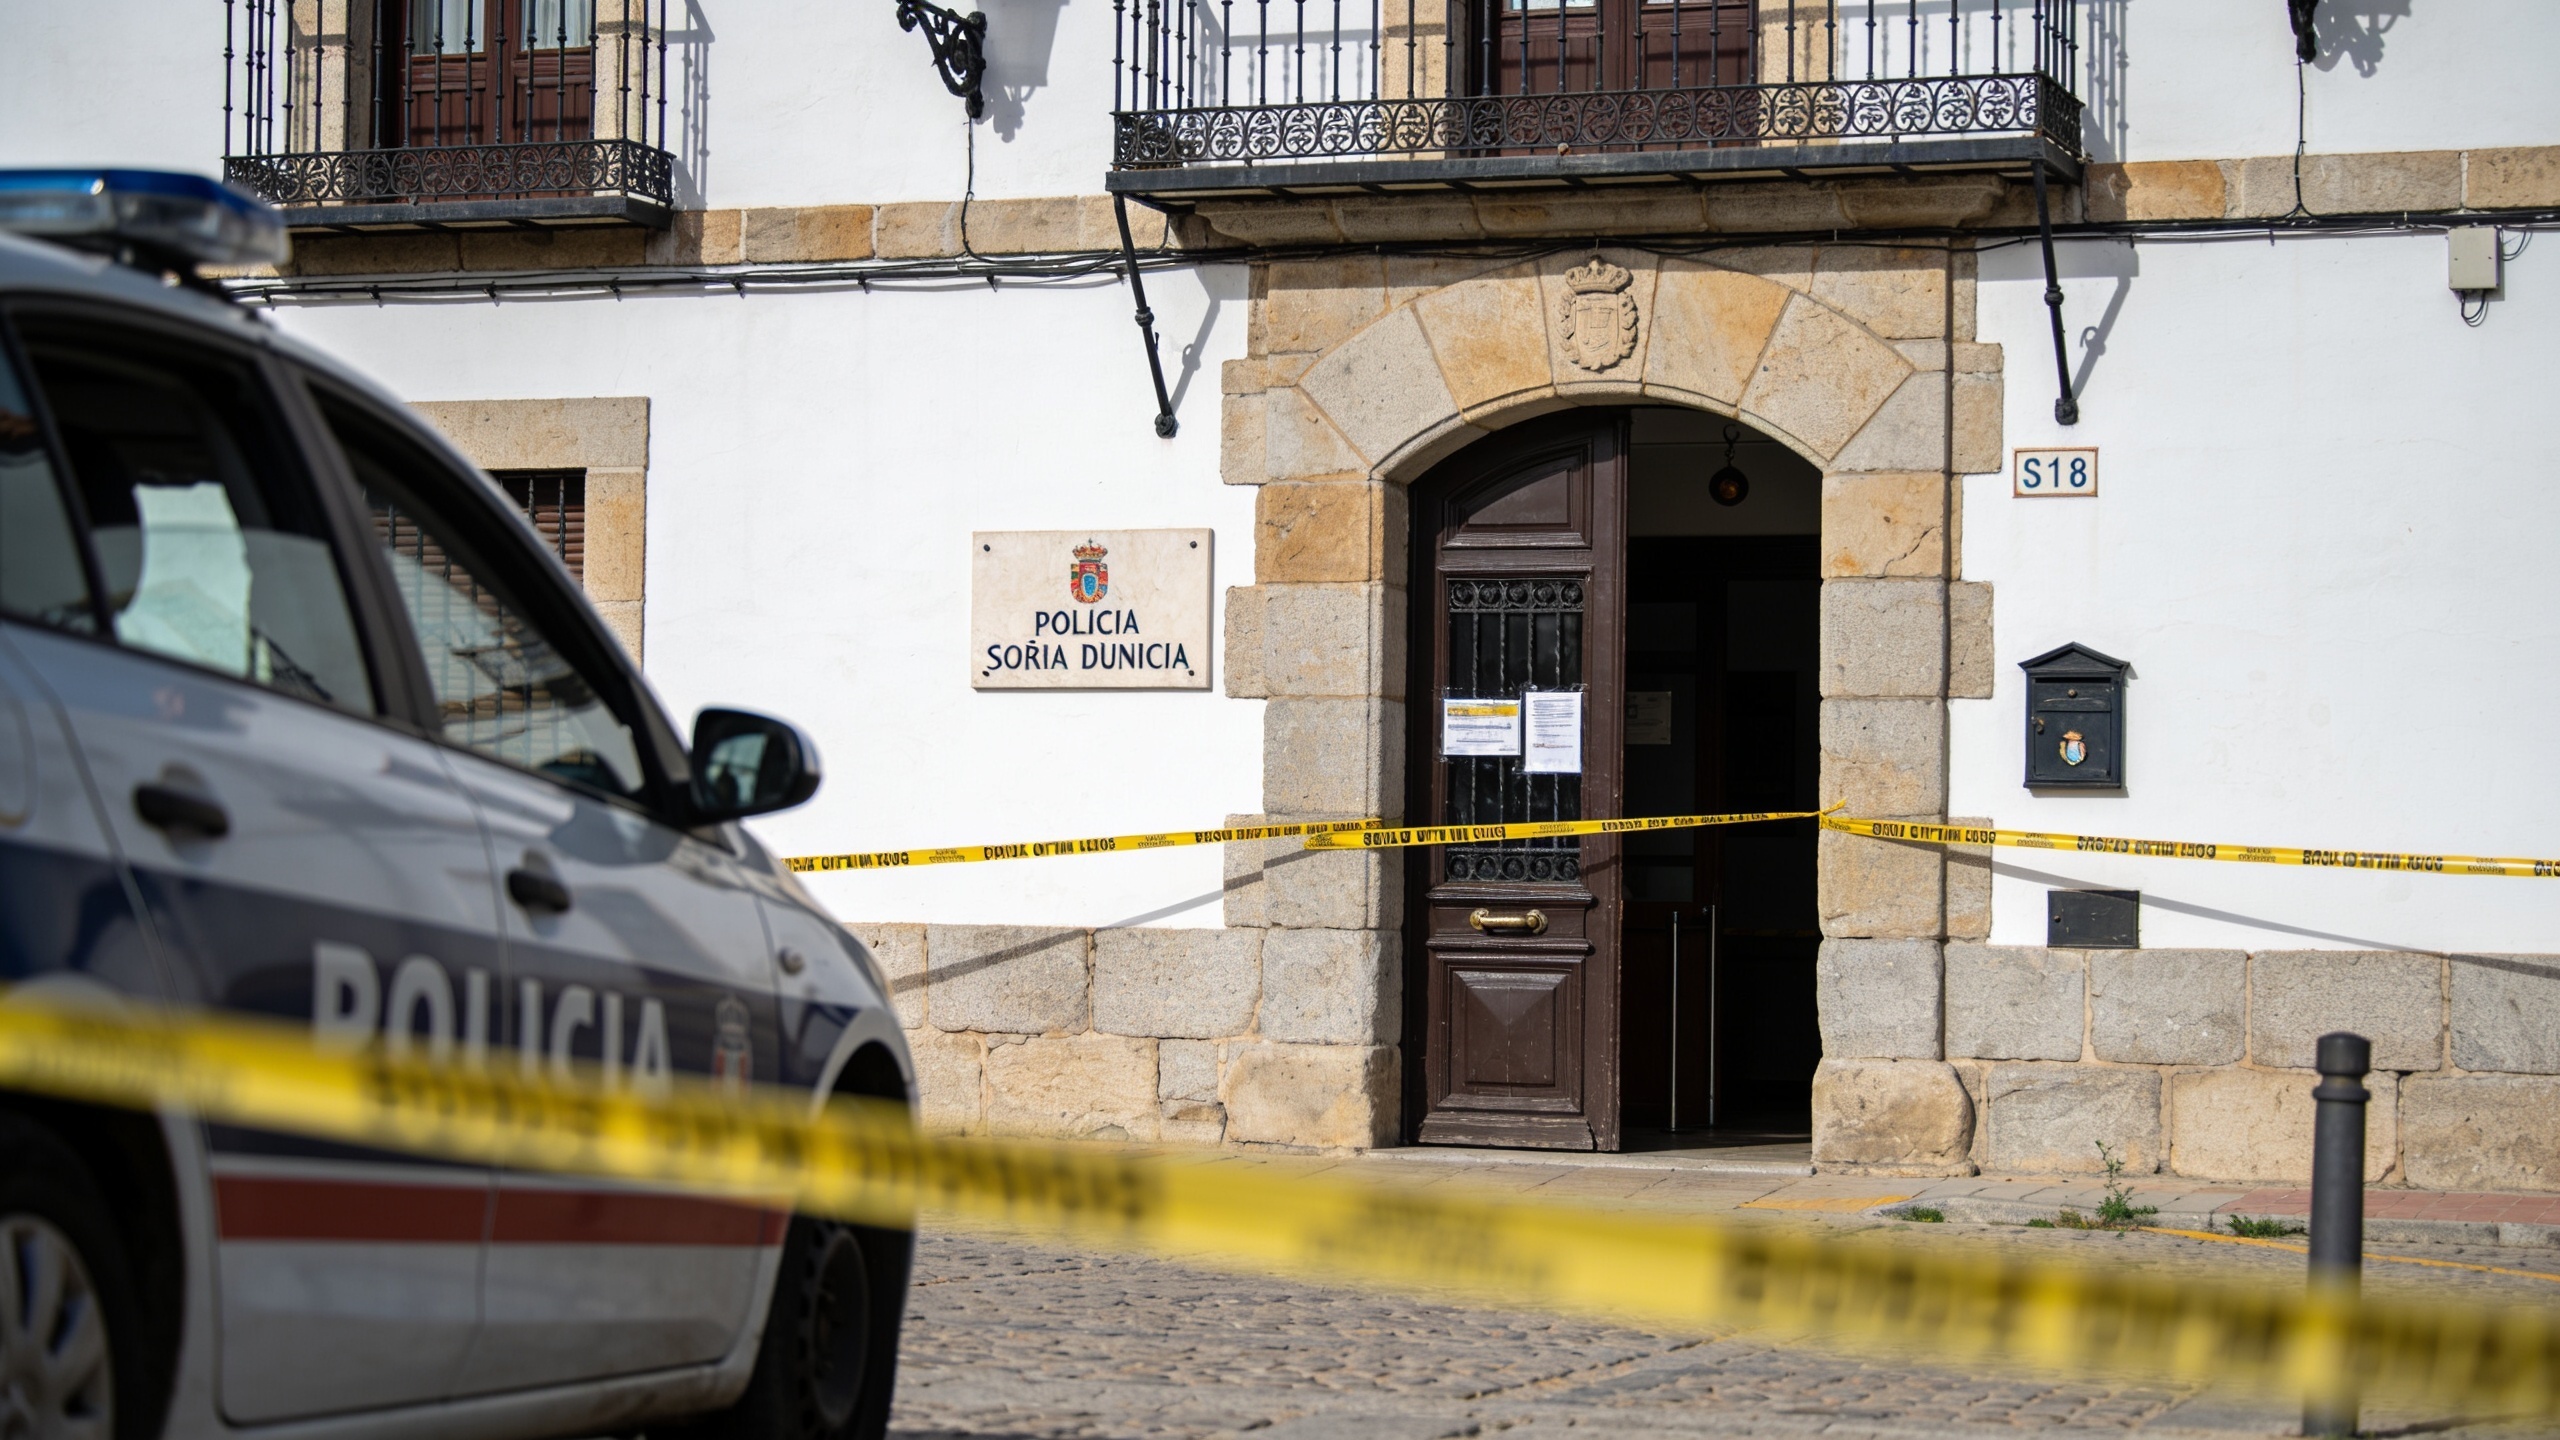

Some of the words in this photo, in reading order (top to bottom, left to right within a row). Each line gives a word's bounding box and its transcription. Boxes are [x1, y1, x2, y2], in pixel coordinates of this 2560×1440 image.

[2022, 457, 2088, 489] S18
[1035, 609, 1140, 637] POLICIA
[1081, 642, 1190, 670] DUNICIA
